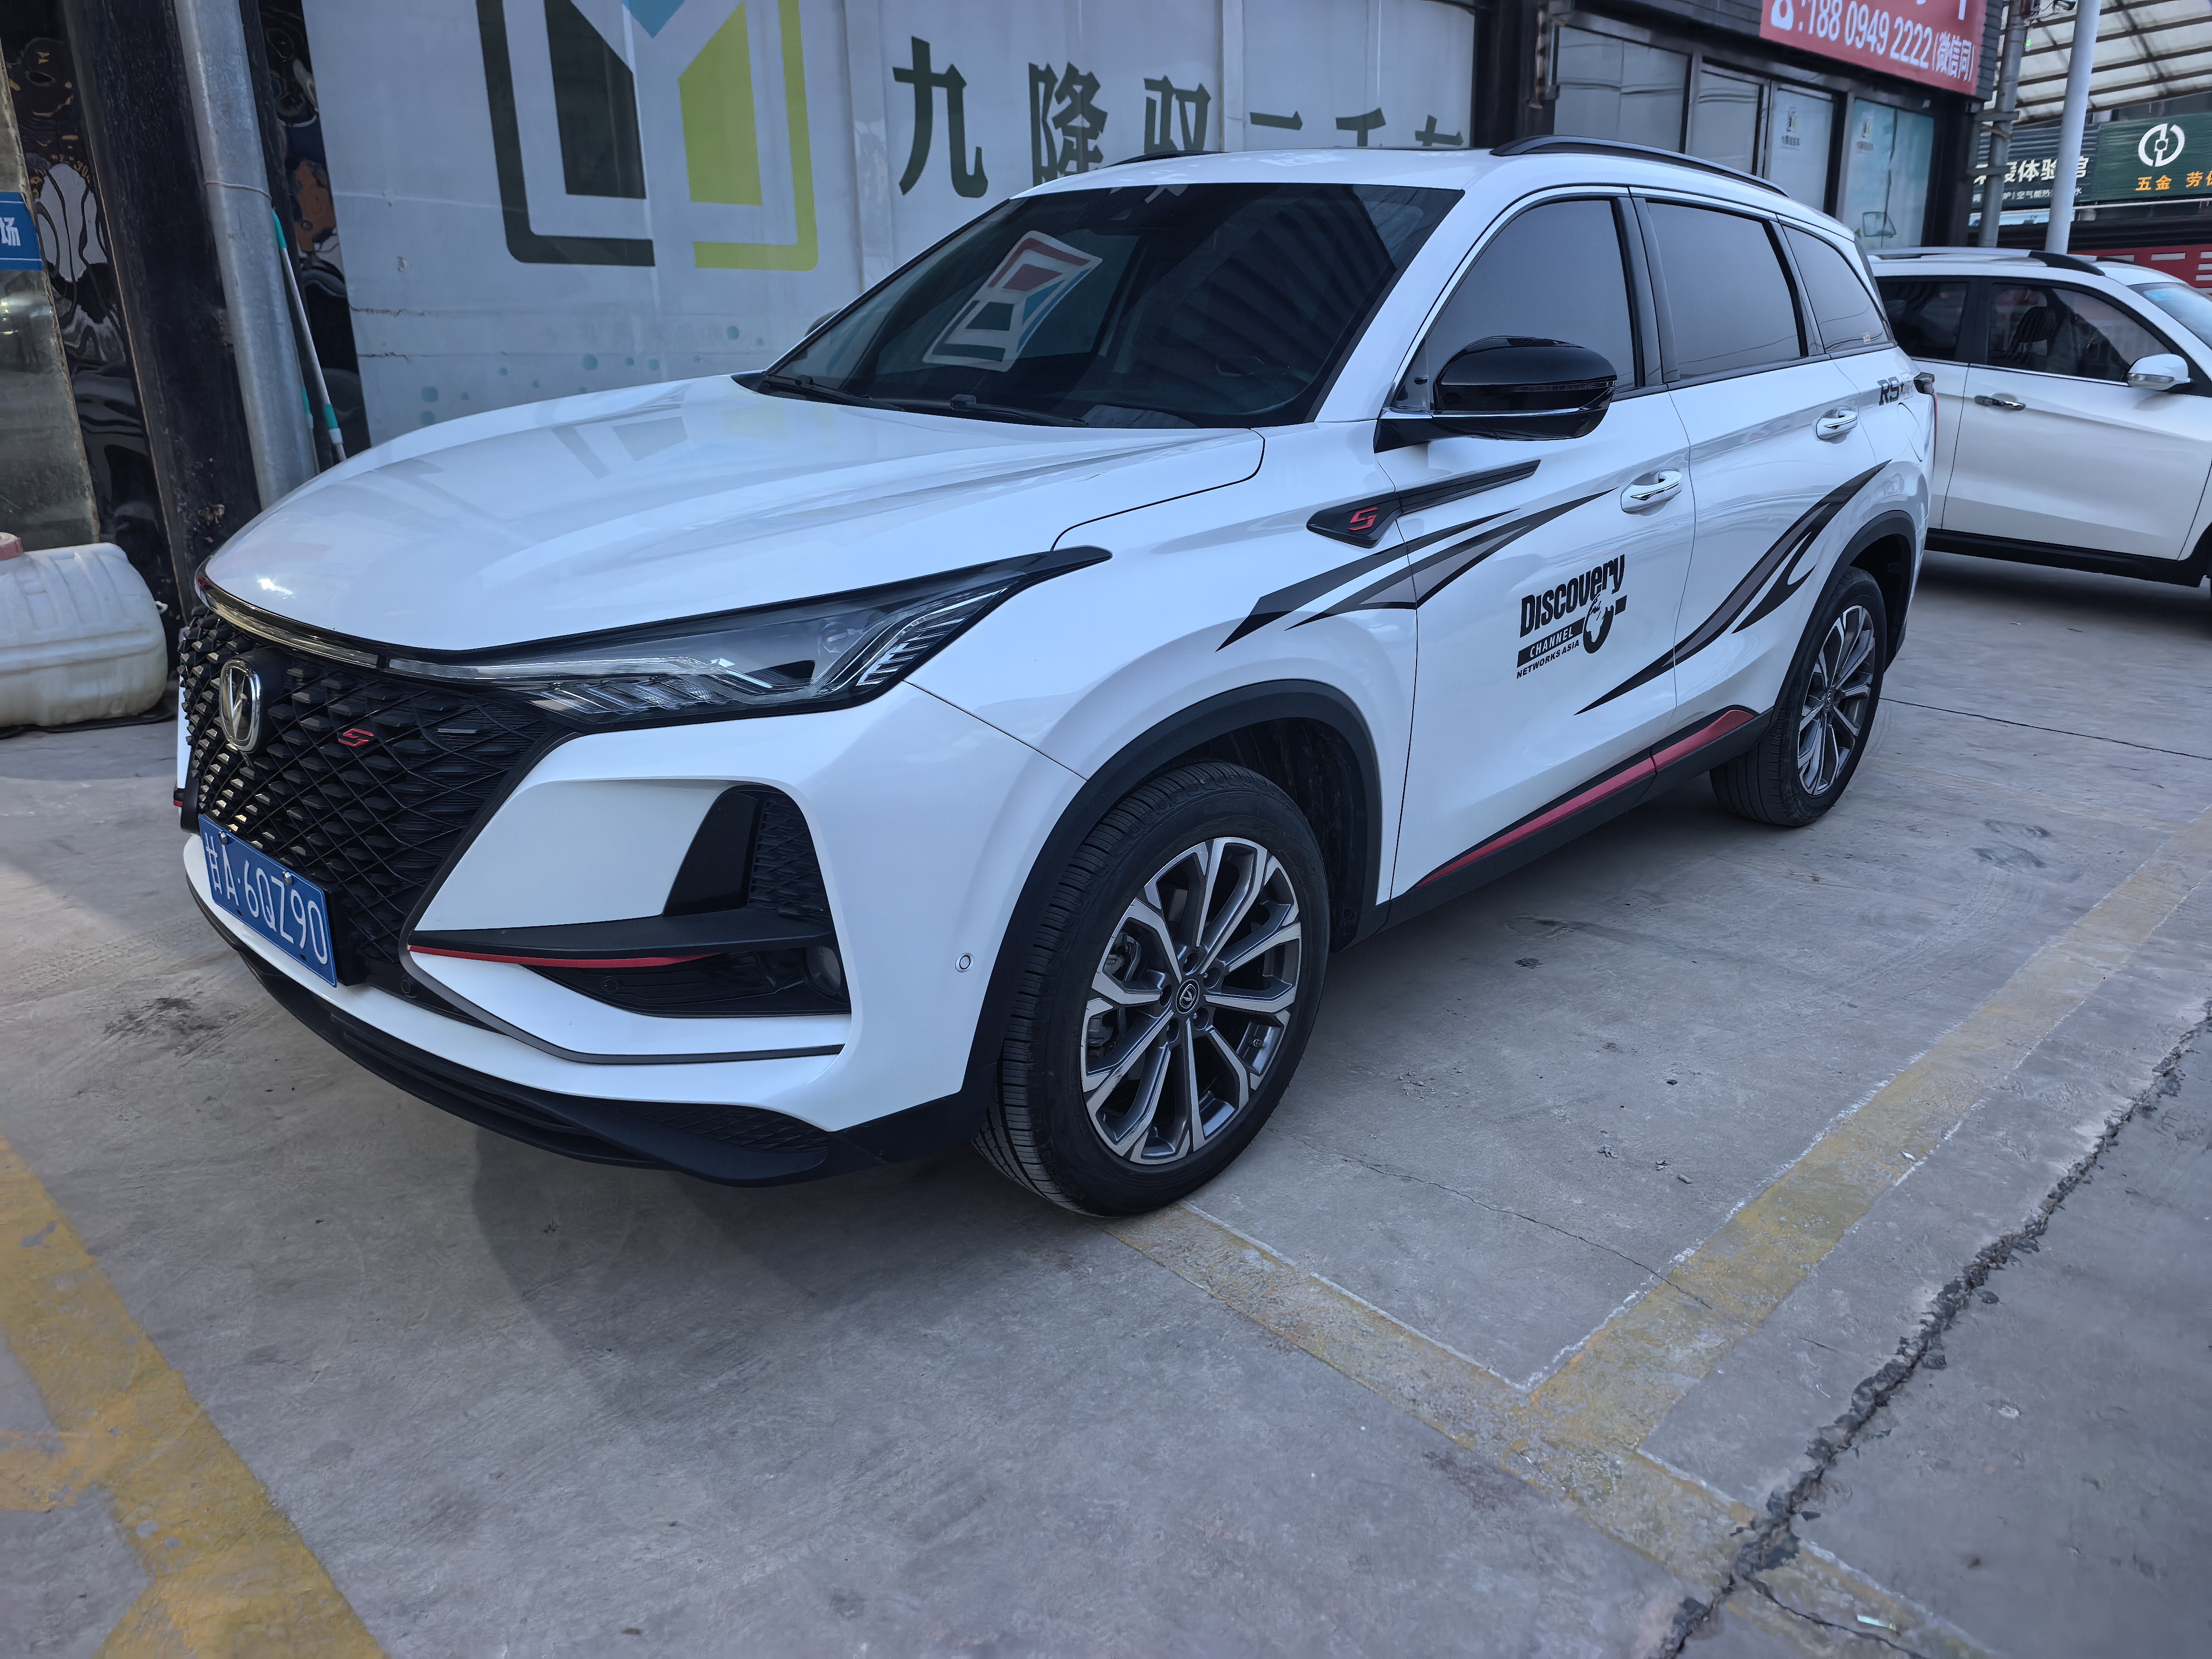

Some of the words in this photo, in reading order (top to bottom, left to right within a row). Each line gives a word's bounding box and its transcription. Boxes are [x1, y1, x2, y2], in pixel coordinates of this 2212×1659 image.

[1845, 1, 1890, 55] 0949
[1890, 16, 1932, 69] 2222
[2135, 174, 2172, 191] 五金
[1516, 649, 1561, 679] NETWORKS
[1561, 639, 1580, 655] ASIA
[1529, 626, 1574, 658] CHANNEL
